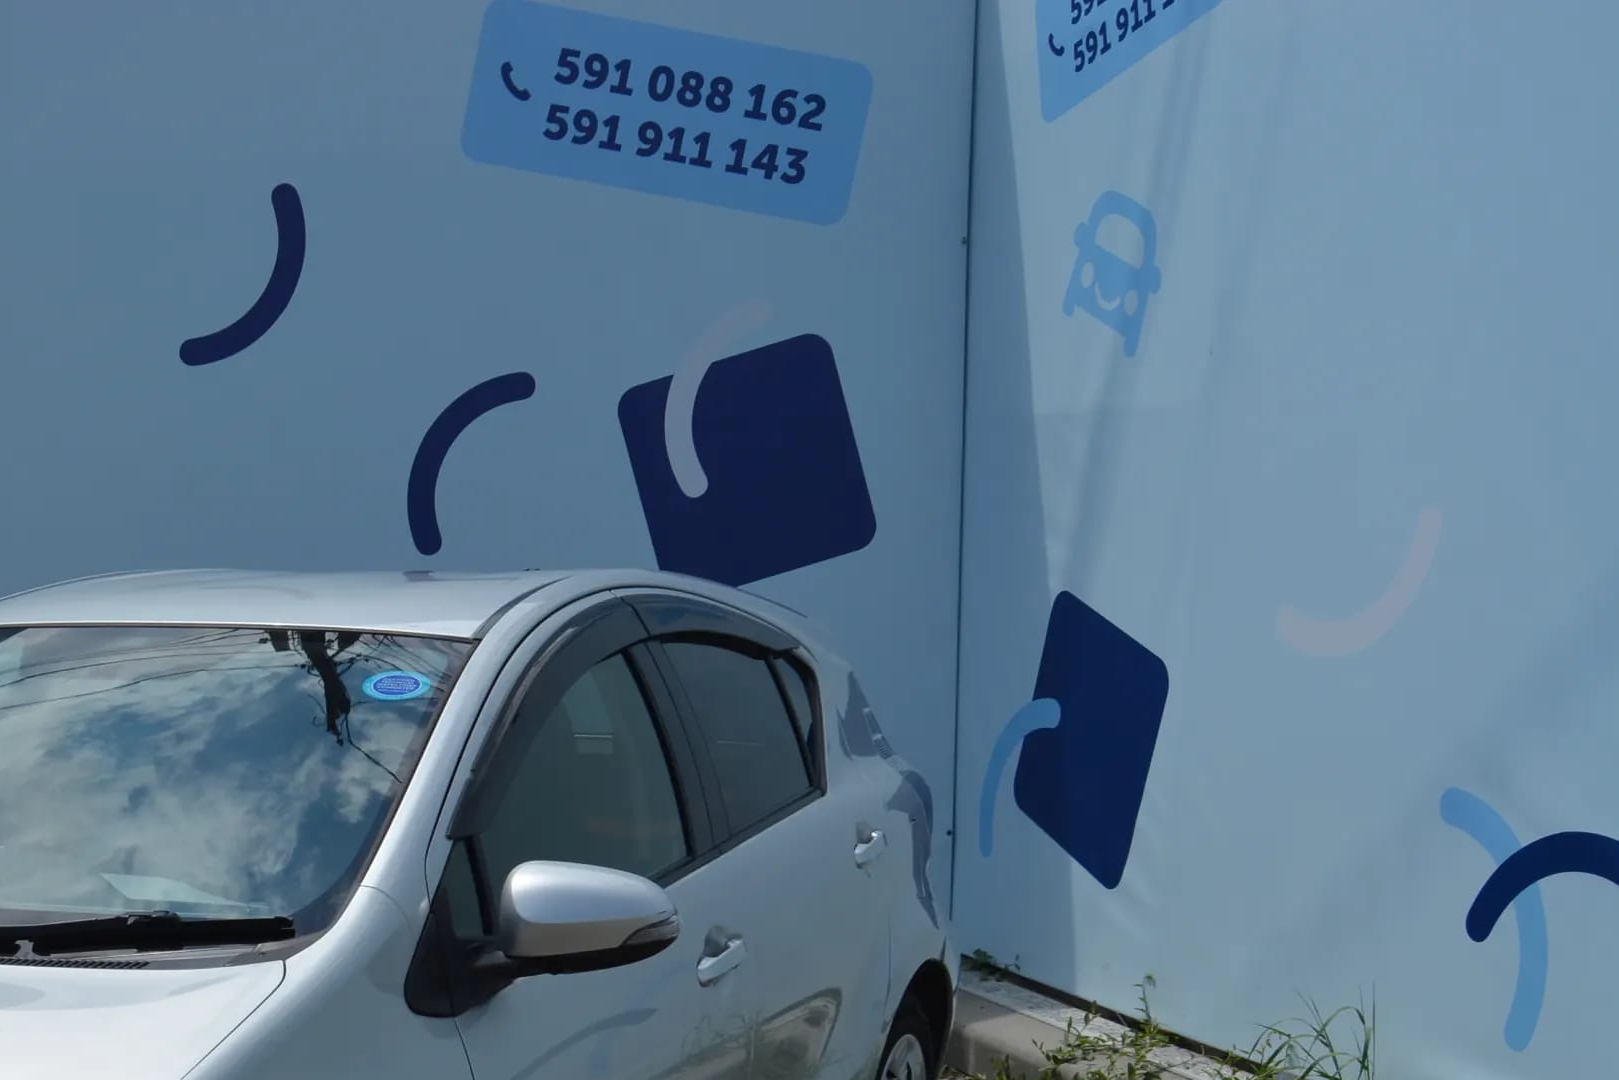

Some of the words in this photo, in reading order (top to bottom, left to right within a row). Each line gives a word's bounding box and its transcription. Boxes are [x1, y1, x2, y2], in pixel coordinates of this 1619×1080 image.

[1073, 21, 1112, 72] 591
[554, 47, 633, 96] 591
[648, 65, 733, 113] 088
[743, 83, 826, 132] 162
[542, 103, 622, 152] 591
[635, 121, 713, 168] 911
[724, 138, 809, 184] 143
